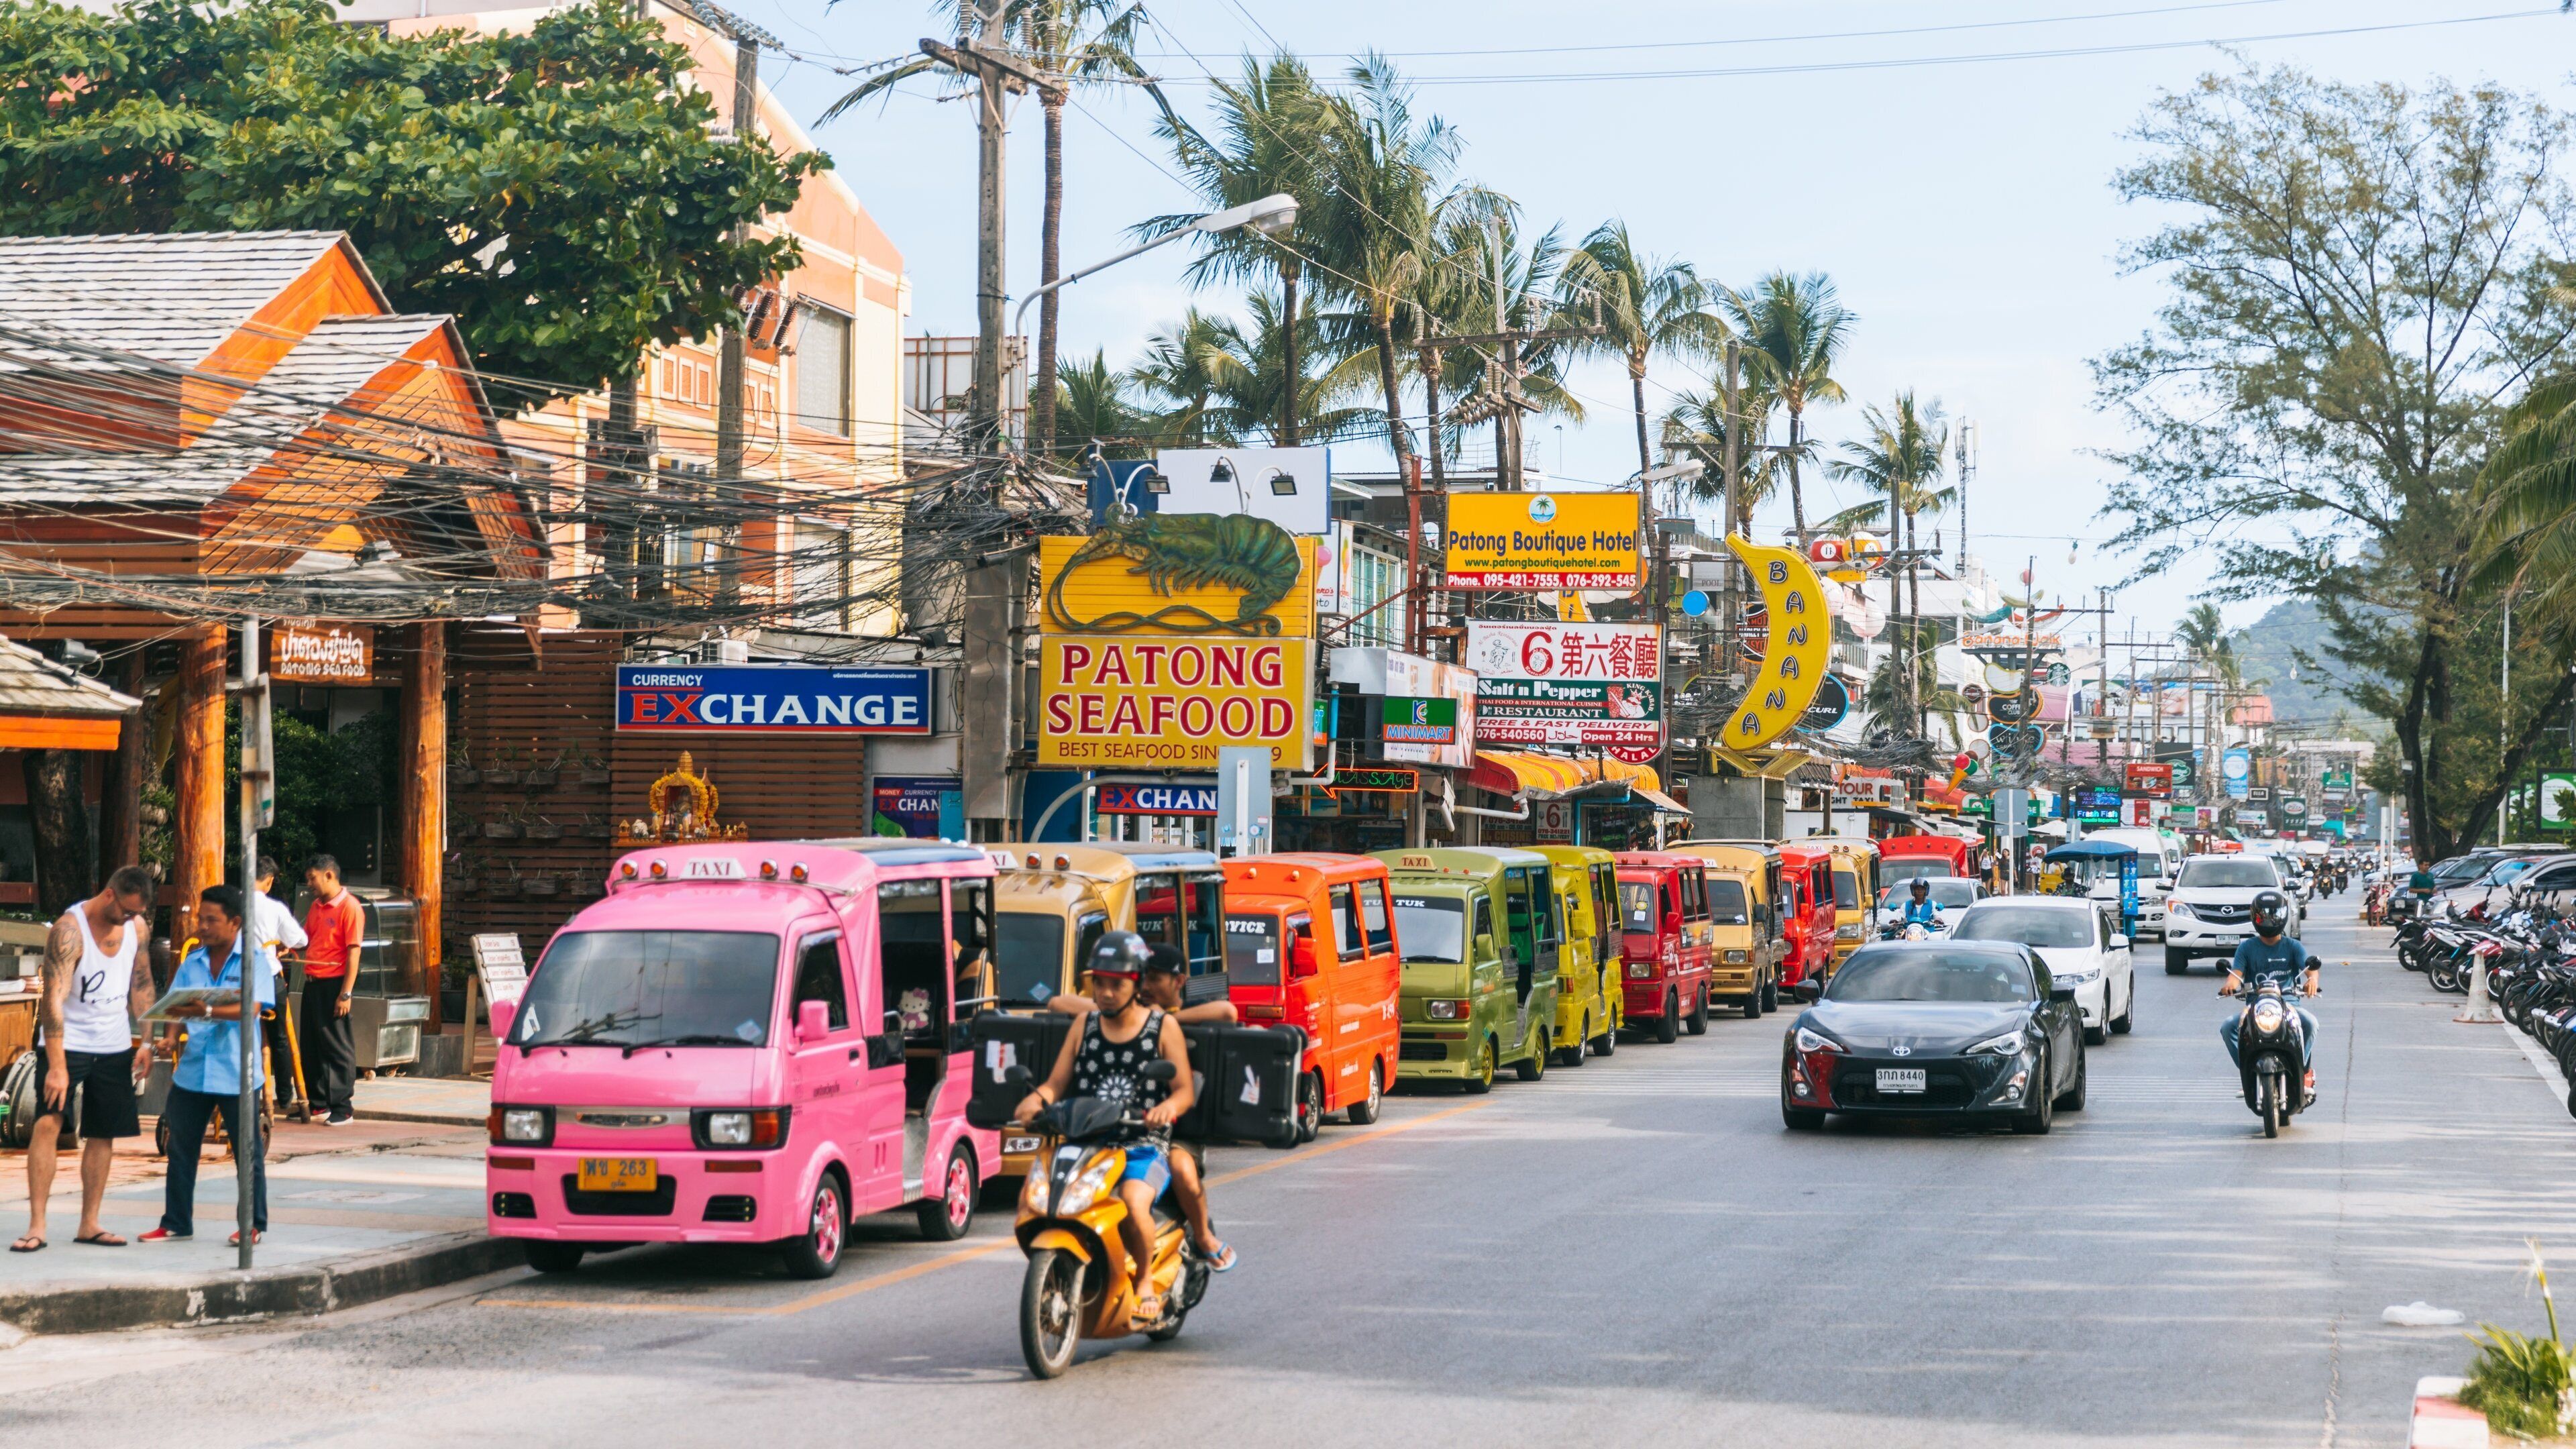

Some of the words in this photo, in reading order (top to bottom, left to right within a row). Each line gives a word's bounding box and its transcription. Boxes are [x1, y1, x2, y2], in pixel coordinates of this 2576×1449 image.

[1449, 531, 1506, 556] Patong
[1513, 530, 1586, 556] Boutique
[1593, 529, 1637, 551] Hotel
[1464, 556, 1620, 570] www.patongboutiquehotel.com
[1448, 575, 1481, 586] Phone.
[1483, 574, 1563, 588] 095-421-7555,
[1566, 574, 1637, 588] 076-292-545
[1521, 631, 1554, 677] 6
[1741, 559, 1807, 735] BANANA
[1560, 632, 1658, 680] 第六餐廳
[280, 662, 321, 676] PATONG
[1060, 644, 1284, 688] PATONG
[632, 674, 703, 687] CURRENCY
[1478, 680, 1529, 697] Salt'n
[1534, 681, 1601, 700] Pepper
[1626, 683, 1646, 692] KING
[1645, 690, 1655, 712] KABAB
[630, 692, 920, 726] EXCHANGE
[1046, 694, 1295, 739] SEAFOOD
[1495, 706, 1603, 718] RESTAURANT
[1387, 725, 1451, 741] MINIMART
[1576, 722, 1652, 730] DELIVERY
[1476, 729, 1544, 741] 076-540560
[1582, 732, 1612, 741] Open
[1615, 731, 1632, 741] 24
[1635, 734, 1654, 742] Hrs
[1059, 742, 1099, 757] BEST
[1104, 743, 1185, 759] SEAFOOD
[1611, 746, 1657, 761] HALAL
[1839, 782, 1873, 795] TOUR
[1546, 804, 1561, 828] 6
[688, 861, 733, 878] TAXI
[1401, 857, 1427, 867] TAXI
[1395, 899, 1425, 907] TUK
[1878, 1071, 1898, 1080] 3กภ
[1900, 1071, 1923, 1080] 8440
[619, 1160, 647, 1176] 263
